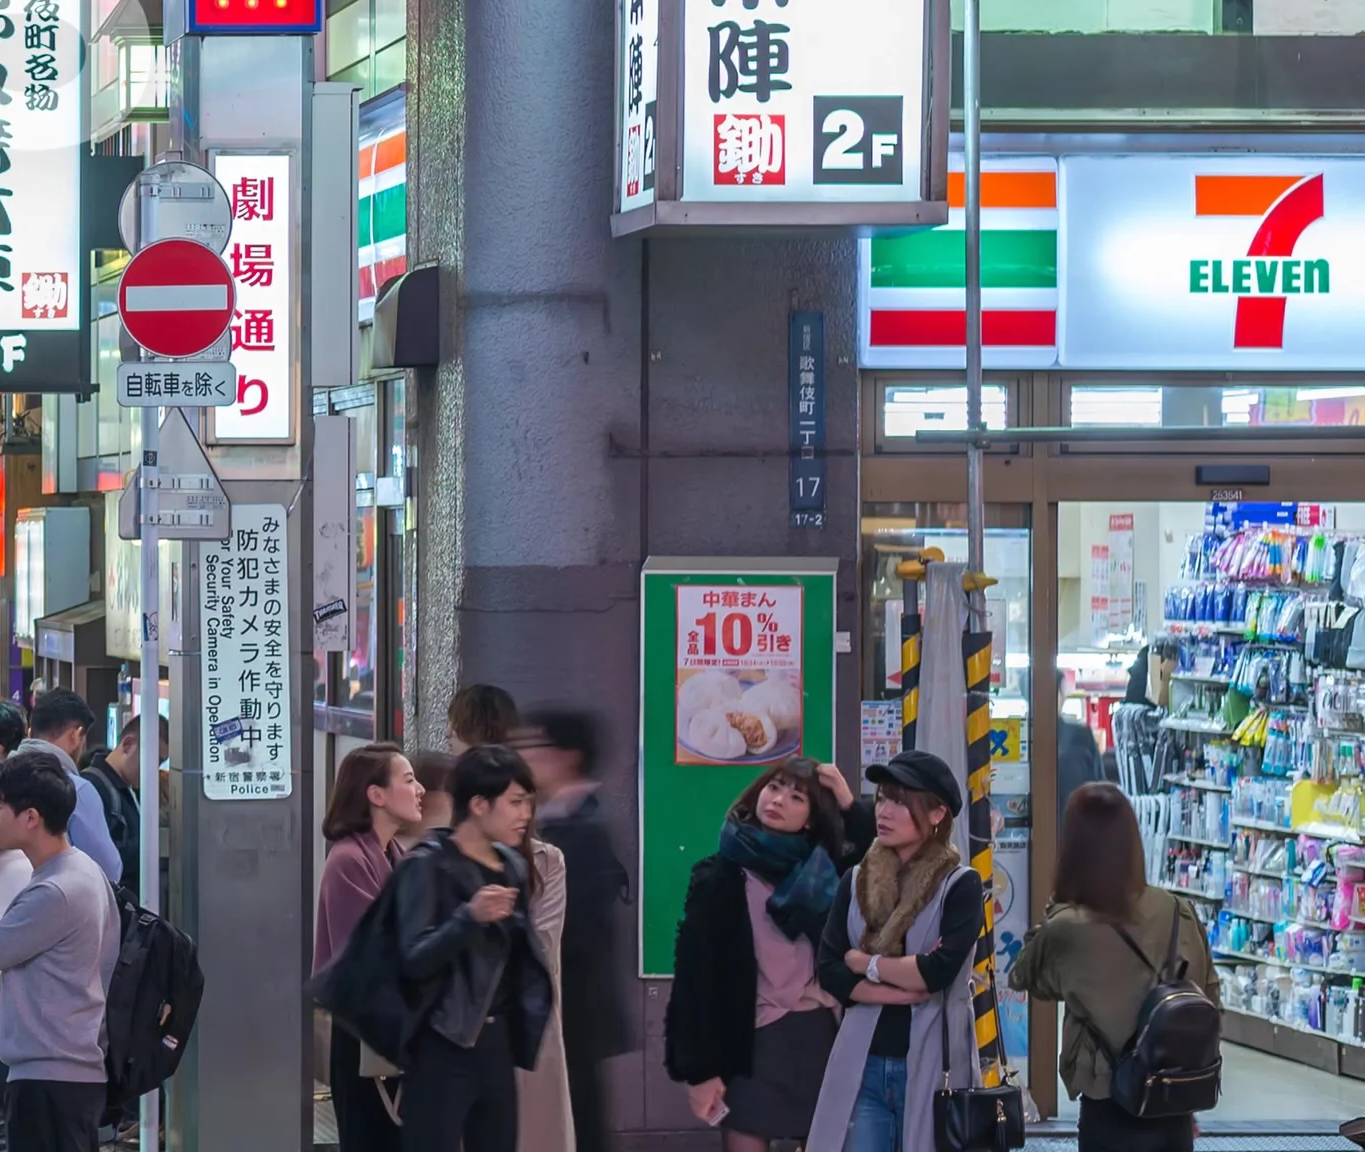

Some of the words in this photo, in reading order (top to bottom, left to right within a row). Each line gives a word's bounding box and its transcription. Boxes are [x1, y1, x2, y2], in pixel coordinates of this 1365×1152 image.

[821, 109, 898, 170] 2F
[231, 177, 275, 416] 劇場通り
[126, 372, 226, 398] 自転車を除く
[795, 476, 821, 498] 17
[795, 513, 823, 527] 17-2
[205, 554, 220, 611] Security
[220, 558, 234, 590] Your
[703, 590, 777, 608] 中華まん
[220, 595, 235, 639] Safety
[206, 617, 221, 672] Camera
[236, 529, 263, 748] 防犯カメラ作動中
[262, 516, 284, 761] みなさまの安全を守ります
[687, 630, 699, 655] 全品
[756, 633, 792, 653] 引き
[208, 677, 221, 689] in
[230, 784, 269, 794] Police
